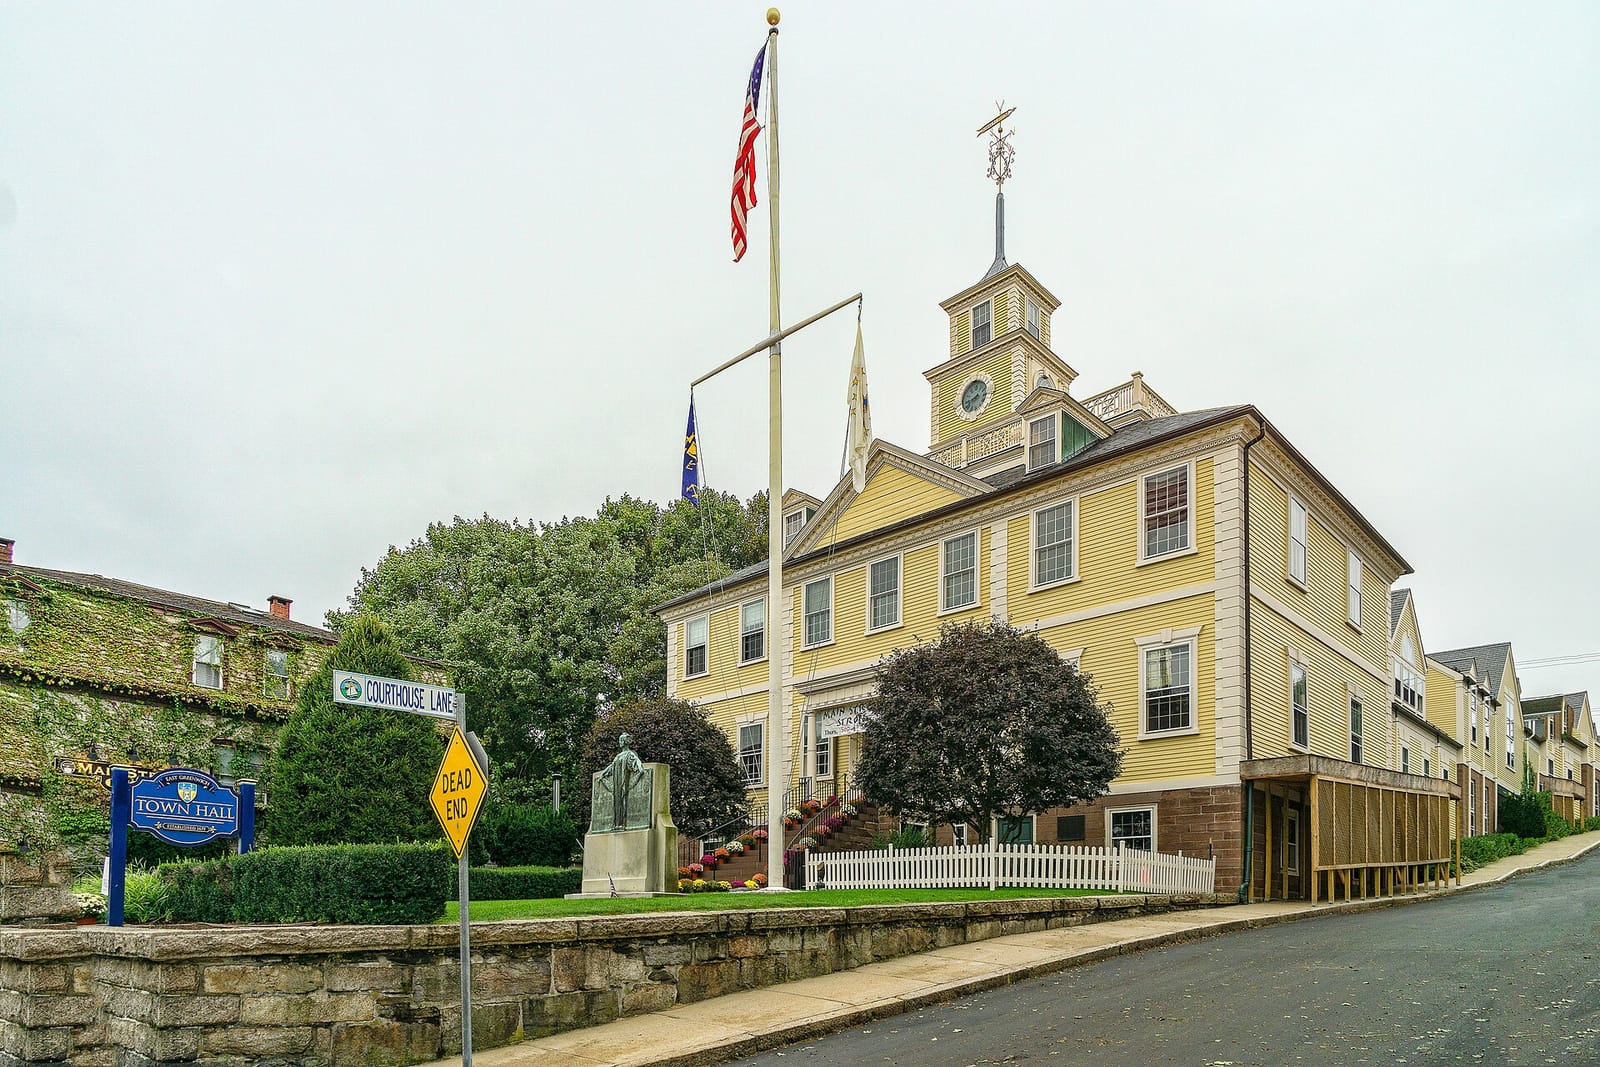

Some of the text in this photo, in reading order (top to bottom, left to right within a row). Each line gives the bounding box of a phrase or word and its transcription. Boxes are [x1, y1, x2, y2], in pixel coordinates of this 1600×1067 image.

[366, 679, 453, 713] COURTHOUSE LANE
[823, 707, 845, 720] MAIN
[78, 762, 111, 776] MAI
[442, 768, 472, 794] DEAD
[136, 799, 235, 819] TOWN HALL
[446, 799, 468, 821] END
